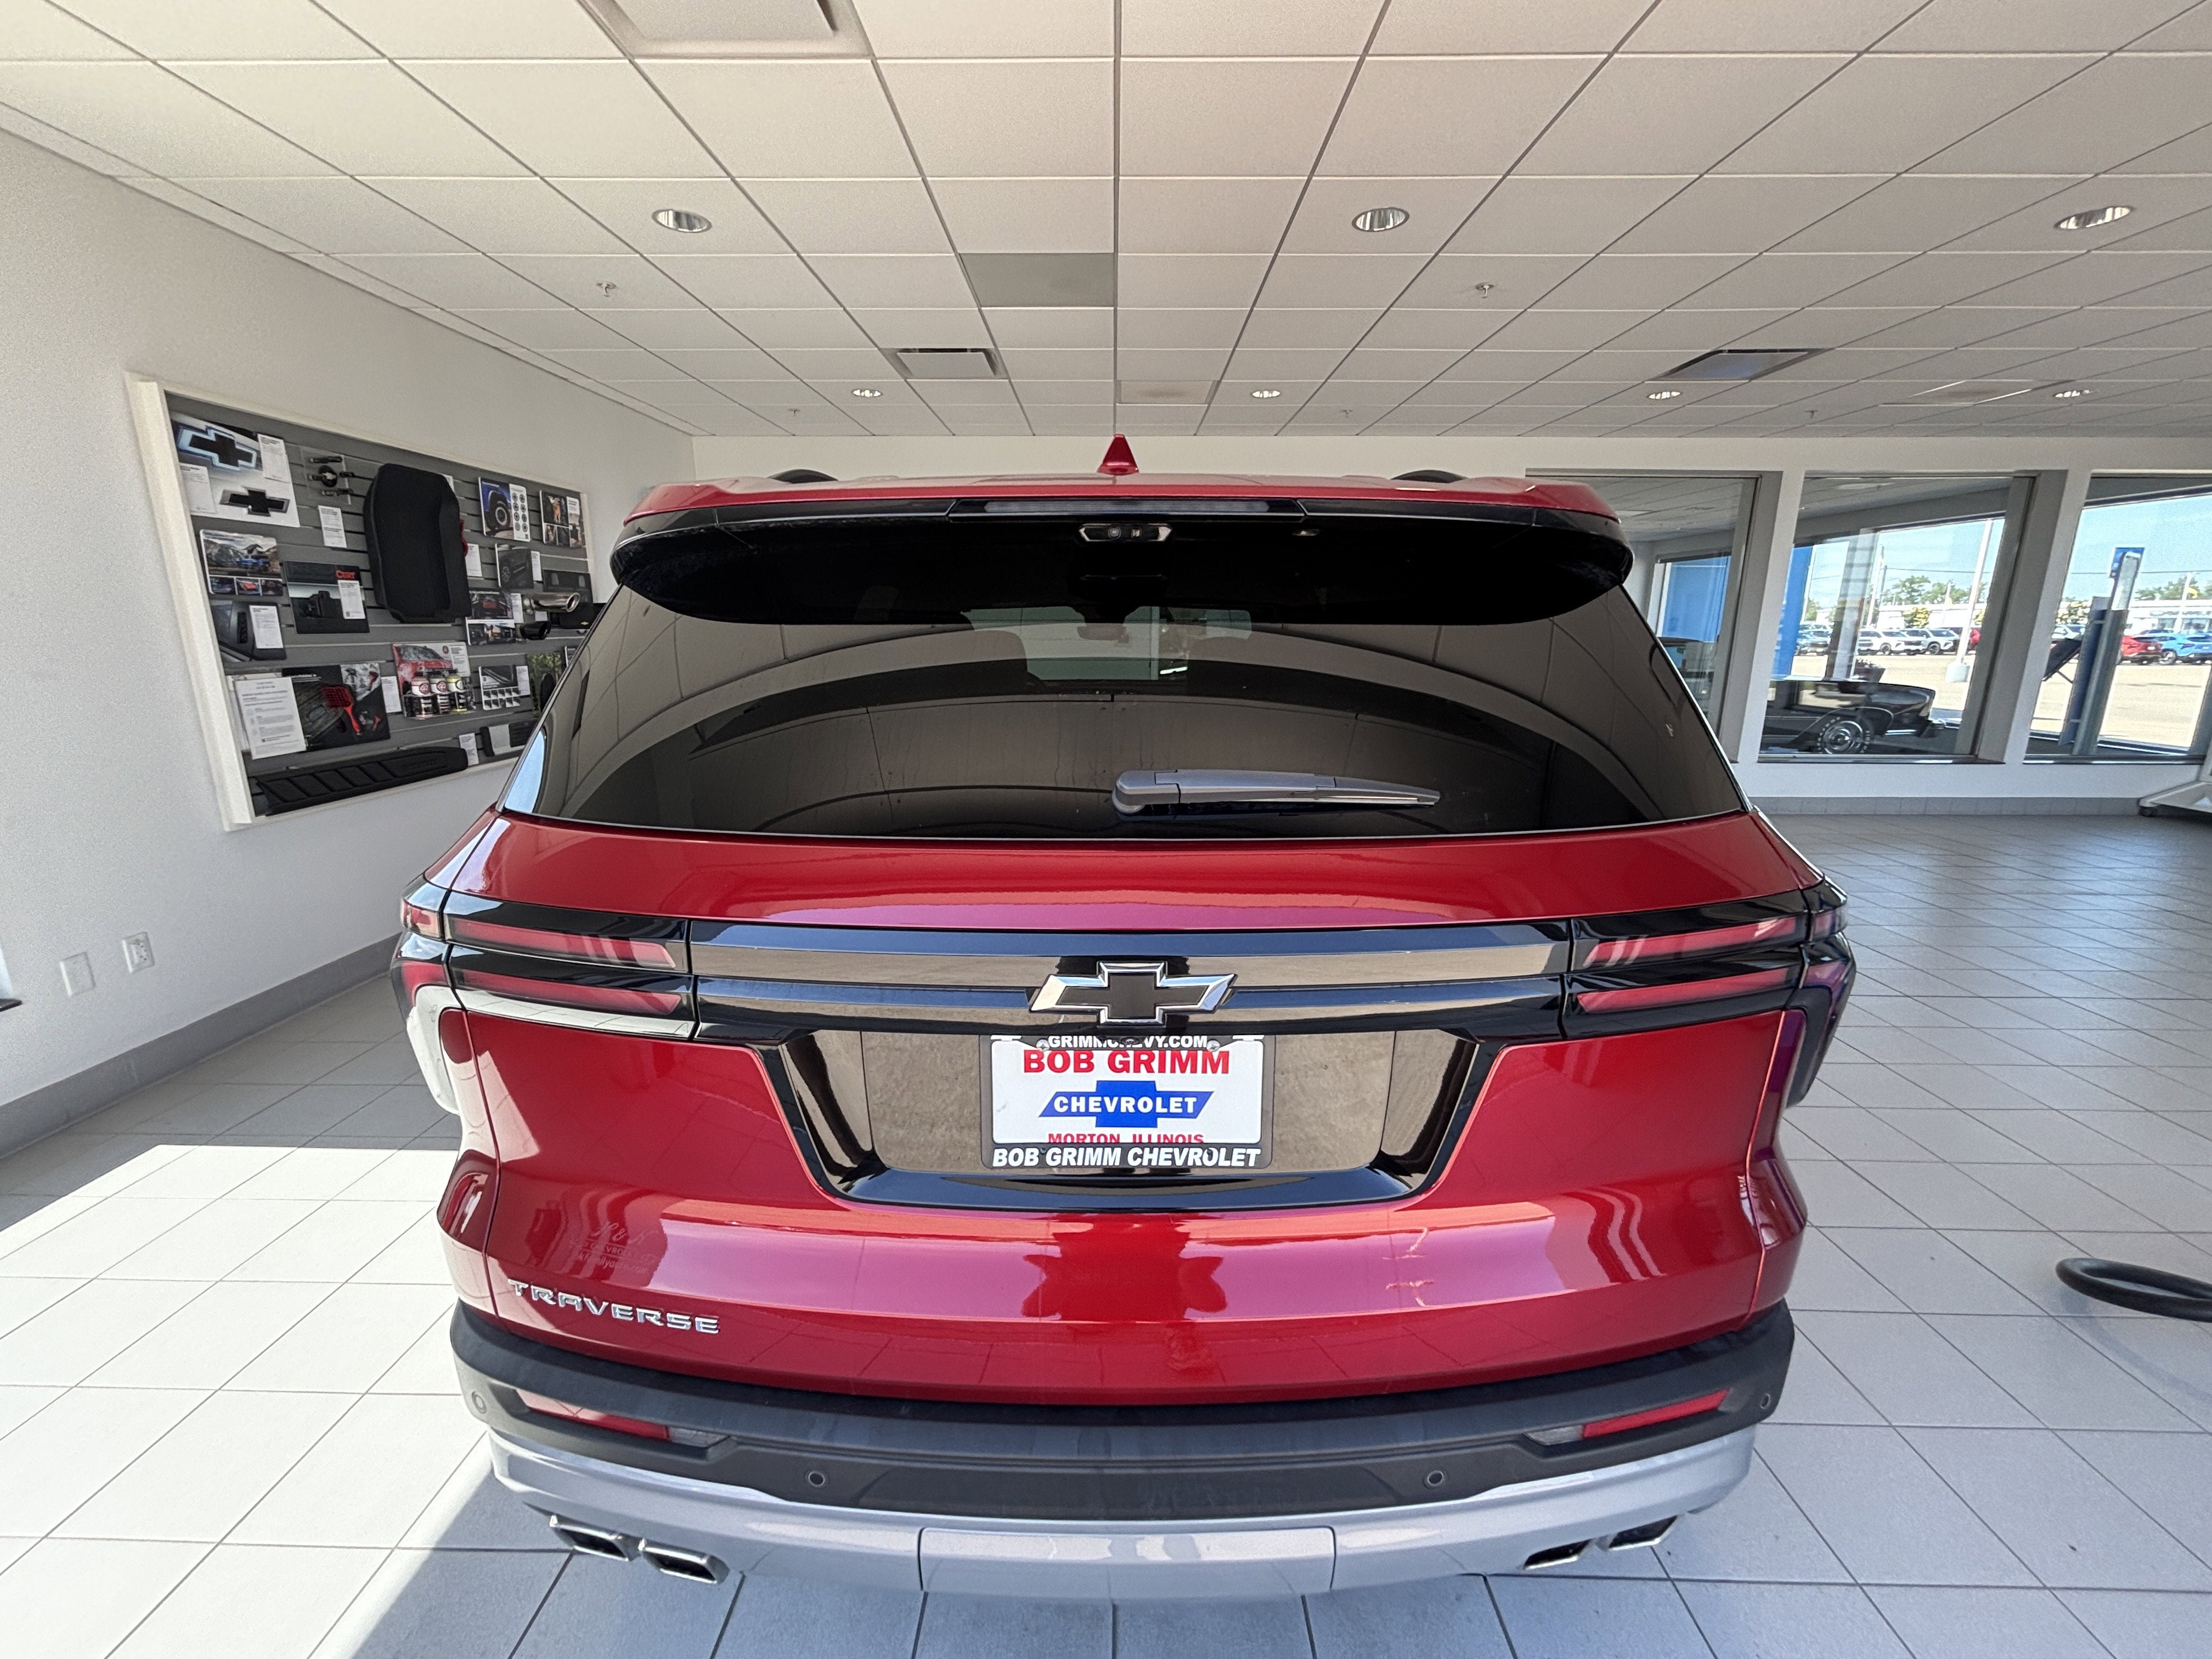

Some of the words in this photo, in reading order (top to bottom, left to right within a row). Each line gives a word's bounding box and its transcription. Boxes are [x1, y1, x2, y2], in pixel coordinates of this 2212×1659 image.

[1047, 1035, 1207, 1048] GRIMMCVY.COM
[1024, 1049, 1094, 1074] BOB
[1107, 1049, 1229, 1074] GRIMM
[1053, 1096, 1197, 1114] CHEVROLET
[1048, 1133, 1120, 1143] MORTON
[992, 1148, 1039, 1167] BOB
[1046, 1147, 1120, 1167] GRIMM
[1127, 1147, 1261, 1167] CHEVROLET
[507, 1278, 720, 1335] TRAVERSE
